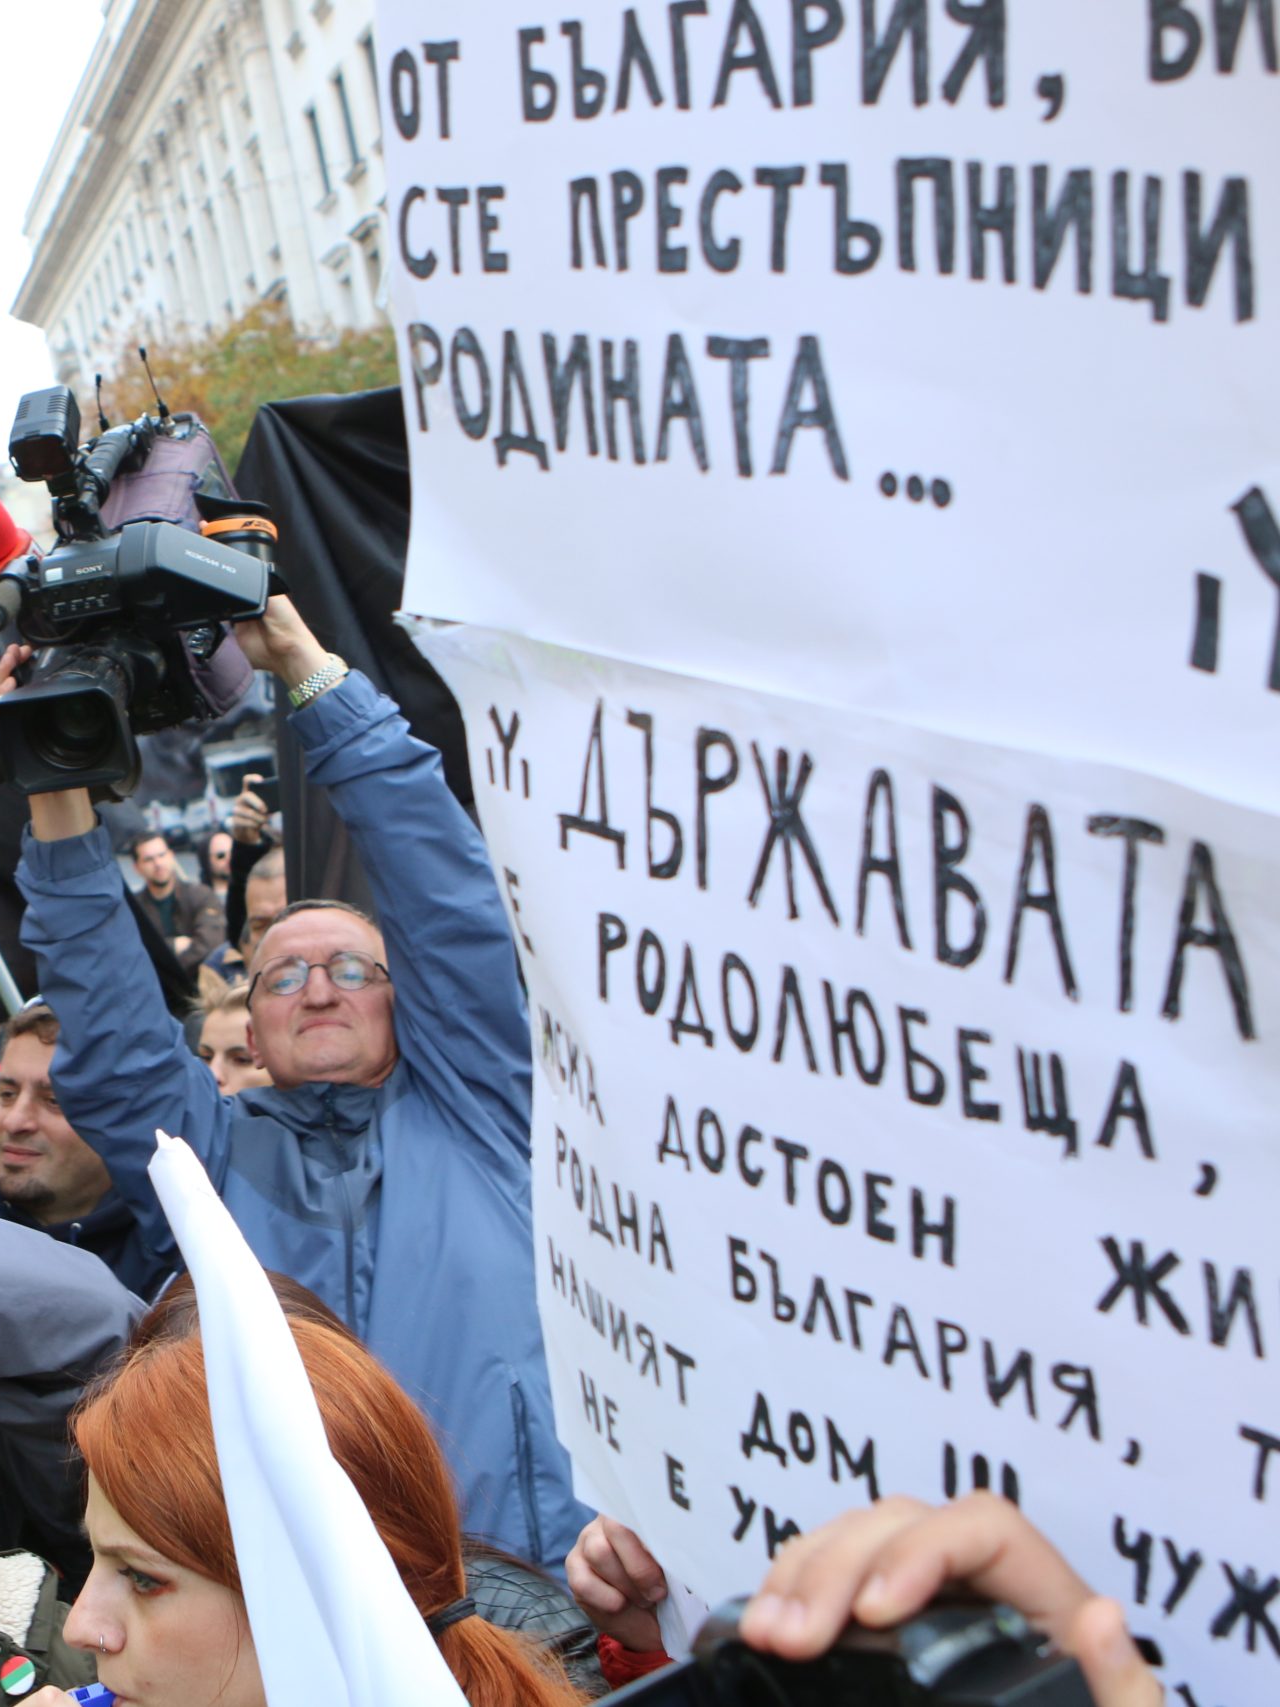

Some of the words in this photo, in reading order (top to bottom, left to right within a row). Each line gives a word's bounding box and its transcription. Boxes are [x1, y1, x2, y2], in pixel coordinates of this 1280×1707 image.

[389, 39, 460, 141] ОТ
[518, 0, 1065, 123] БЪЛГАРИЯ,
[397, 184, 509, 281] СТЕ
[568, 156, 1256, 325] ПРЕСТЪПНИЦИ
[406, 323, 953, 509] РОДИНАТА...
[75, 563, 104, 576] SONY
[556, 696, 1259, 1043] ДЪРЖАВАТА
[597, 911, 1218, 1197] РОДОЛЮБЕЩА,
[554, 1122, 675, 1274] РОДНА
[726, 1234, 1142, 1467] БЪЛГАРИЯ,
[656, 1092, 958, 1269] ДОСТОЕН
[1094, 1234, 1280, 1361] ЖИ
[547, 1234, 697, 1407] НАШИЯТ
[740, 1390, 883, 1504] ДОМ
[579, 1368, 622, 1454] НЕ
[664, 1451, 692, 1512] Е
